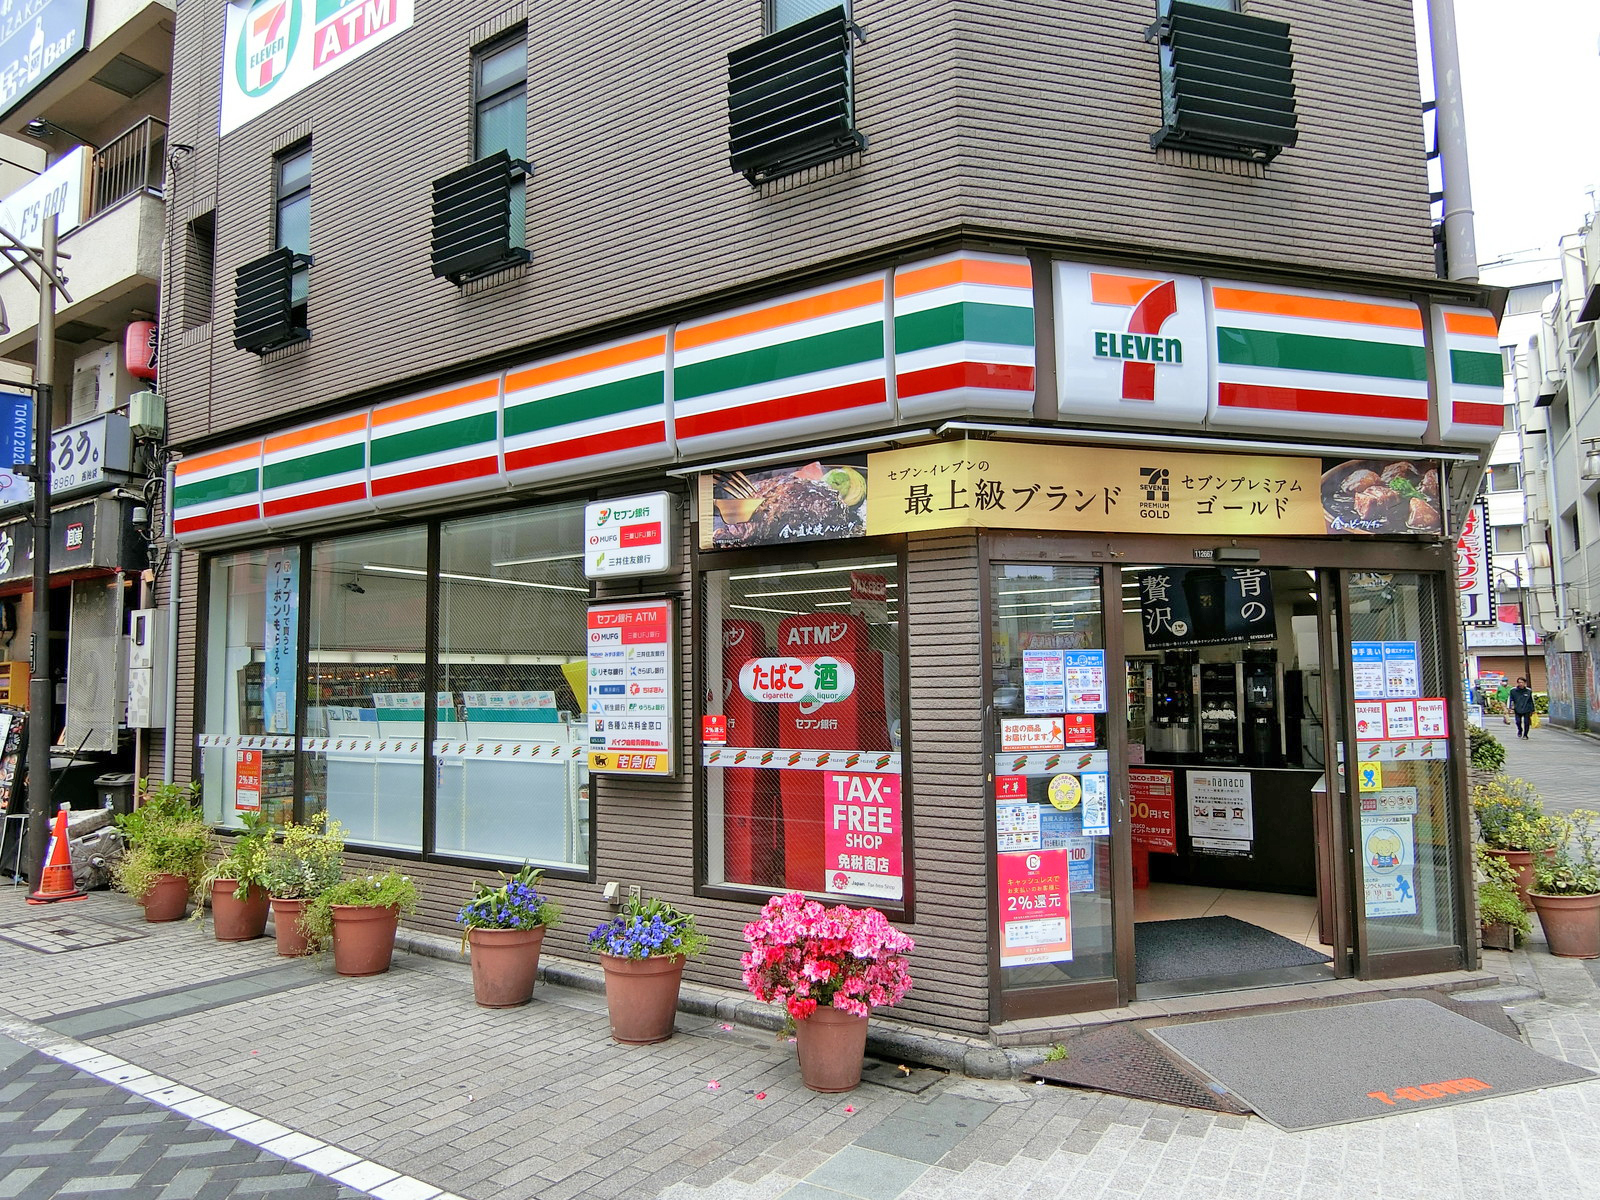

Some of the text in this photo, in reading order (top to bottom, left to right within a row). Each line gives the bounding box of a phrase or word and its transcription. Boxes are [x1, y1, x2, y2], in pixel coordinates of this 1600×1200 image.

[1, 0, 50, 40] IZAKA
[319, 0, 391, 64] ATM
[43, 29, 76, 69] Bar
[13, 403, 28, 465] TOKYO 2020
[51, 430, 99, 473] ろう。
[887, 460, 990, 481] セブン-イレブンの
[1181, 474, 1302, 494] セブンプレミアム
[904, 478, 1122, 516] 最上級ブランド
[613, 507, 650, 521] セブン銀行
[1140, 509, 1170, 519] GOLD
[1196, 495, 1289, 520] ゴールド
[600, 535, 618, 543] MUFG
[624, 530, 657, 540] 三菱UFJ銀行
[608, 555, 651, 566] 三井住友銀行
[1142, 574, 1173, 635] 贅沢
[282, 577, 291, 655] アプリで買うと
[597, 611, 657, 624] セブン銀行 ATM
[786, 625, 831, 646] ATM
[598, 668, 624, 676] りそな銀行
[752, 662, 838, 691] たばこ 酒
[762, 692, 839, 700] cigarette liquor
[1356, 706, 1381, 714] TAX-FREE
[607, 721, 662, 730] 各種公共料金窓口
[795, 718, 838, 730] セブン銀行
[1004, 724, 1042, 733] お店の商品
[1068, 727, 1092, 735] 2%還元
[618, 754, 657, 769] 宅急便
[832, 775, 892, 803] TAX-
[832, 804, 893, 834] FREE
[845, 833, 883, 849] SHOP
[1069, 848, 1086, 860] 100
[837, 853, 890, 873] 免税商店
[1007, 876, 1061, 886] キャッシュレスで
[1007, 885, 1061, 895] お支払いのお客様に
[1007, 893, 1062, 911] 2%還元
